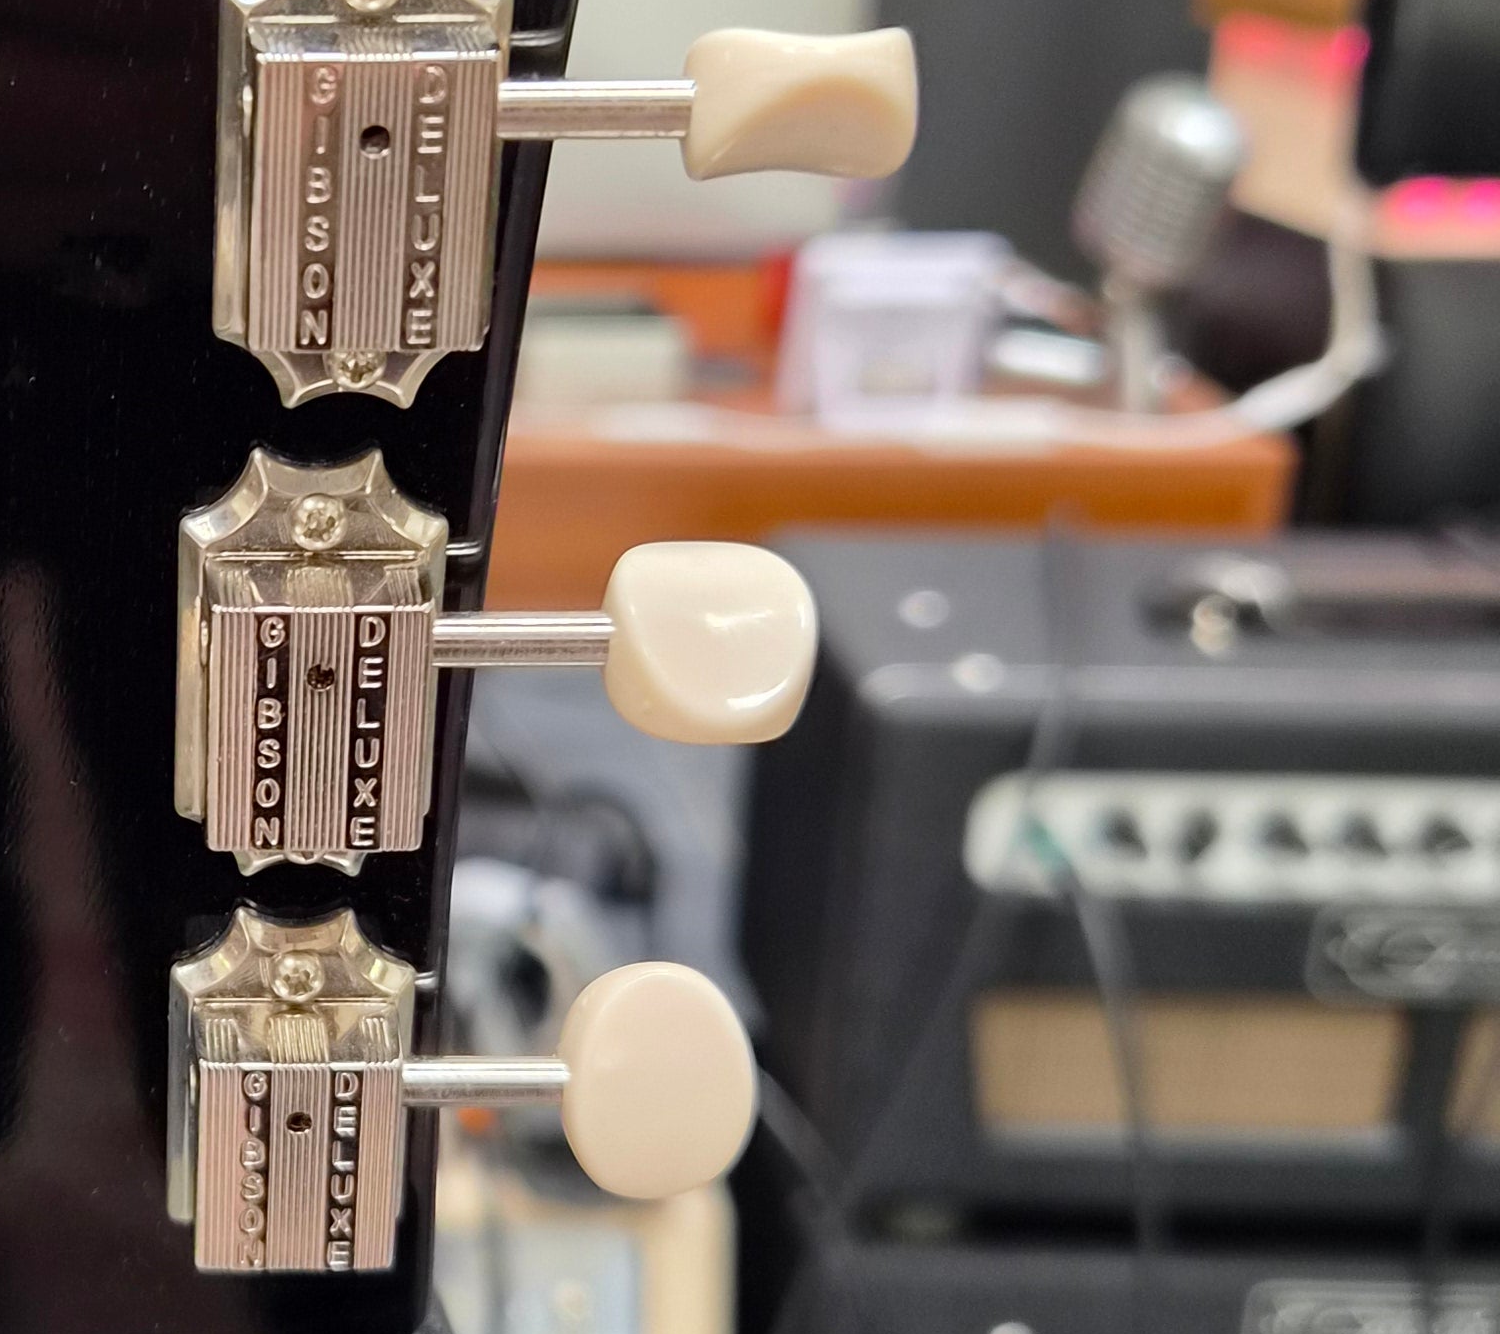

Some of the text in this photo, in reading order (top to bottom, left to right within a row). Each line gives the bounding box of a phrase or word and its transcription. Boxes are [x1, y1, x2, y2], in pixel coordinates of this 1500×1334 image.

[300, 67, 338, 346] GIBSON
[407, 66, 447, 345] DELUXE
[253, 616, 286, 847] GIBSON
[350, 615, 386, 847] DELUXE
[239, 1070, 269, 1267] GIBSON
[327, 1070, 359, 1271] DELUXE
